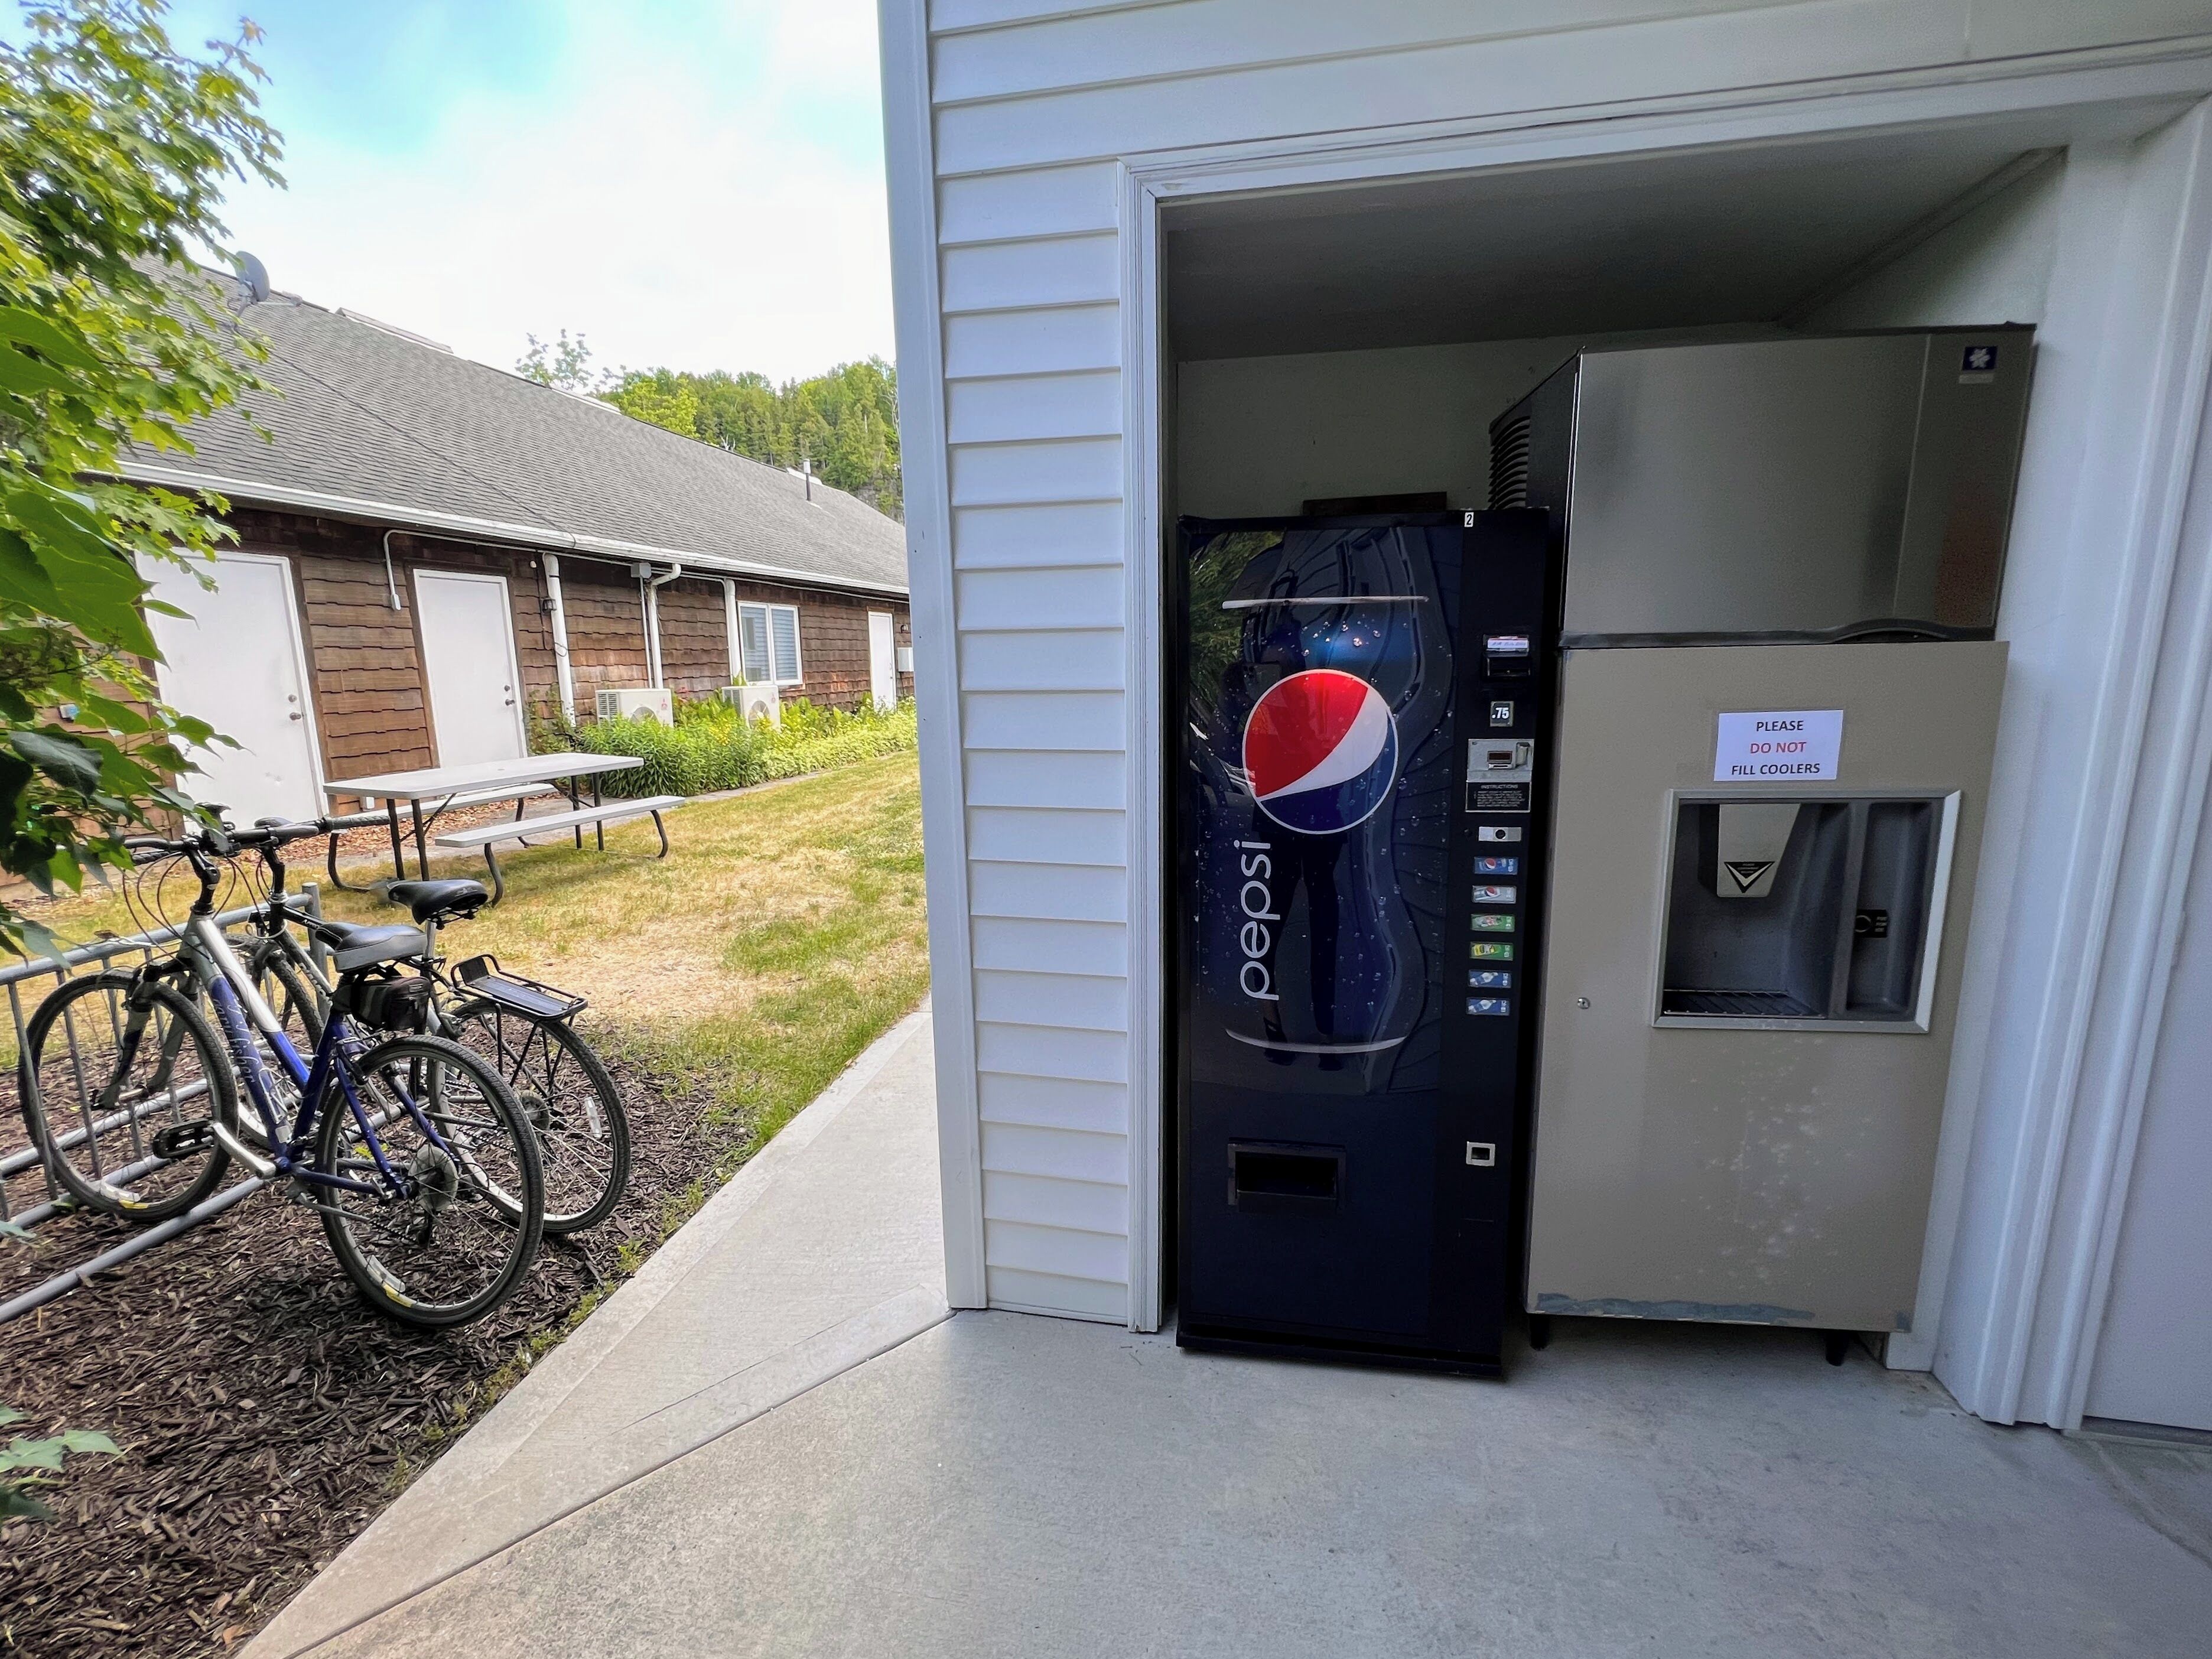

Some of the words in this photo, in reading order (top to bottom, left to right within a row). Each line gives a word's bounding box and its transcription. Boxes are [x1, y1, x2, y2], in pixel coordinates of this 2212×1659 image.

[1466, 514, 1472, 525] 2
[1492, 707, 1509, 719] .75
[1756, 720, 1804, 732] PLEASE
[1750, 743, 1771, 754] DO
[1775, 741, 1807, 753] NOT
[1731, 765, 1755, 775] FILL
[1759, 763, 1820, 775] COOLERS
[1234, 840, 1280, 1000] pepsi
